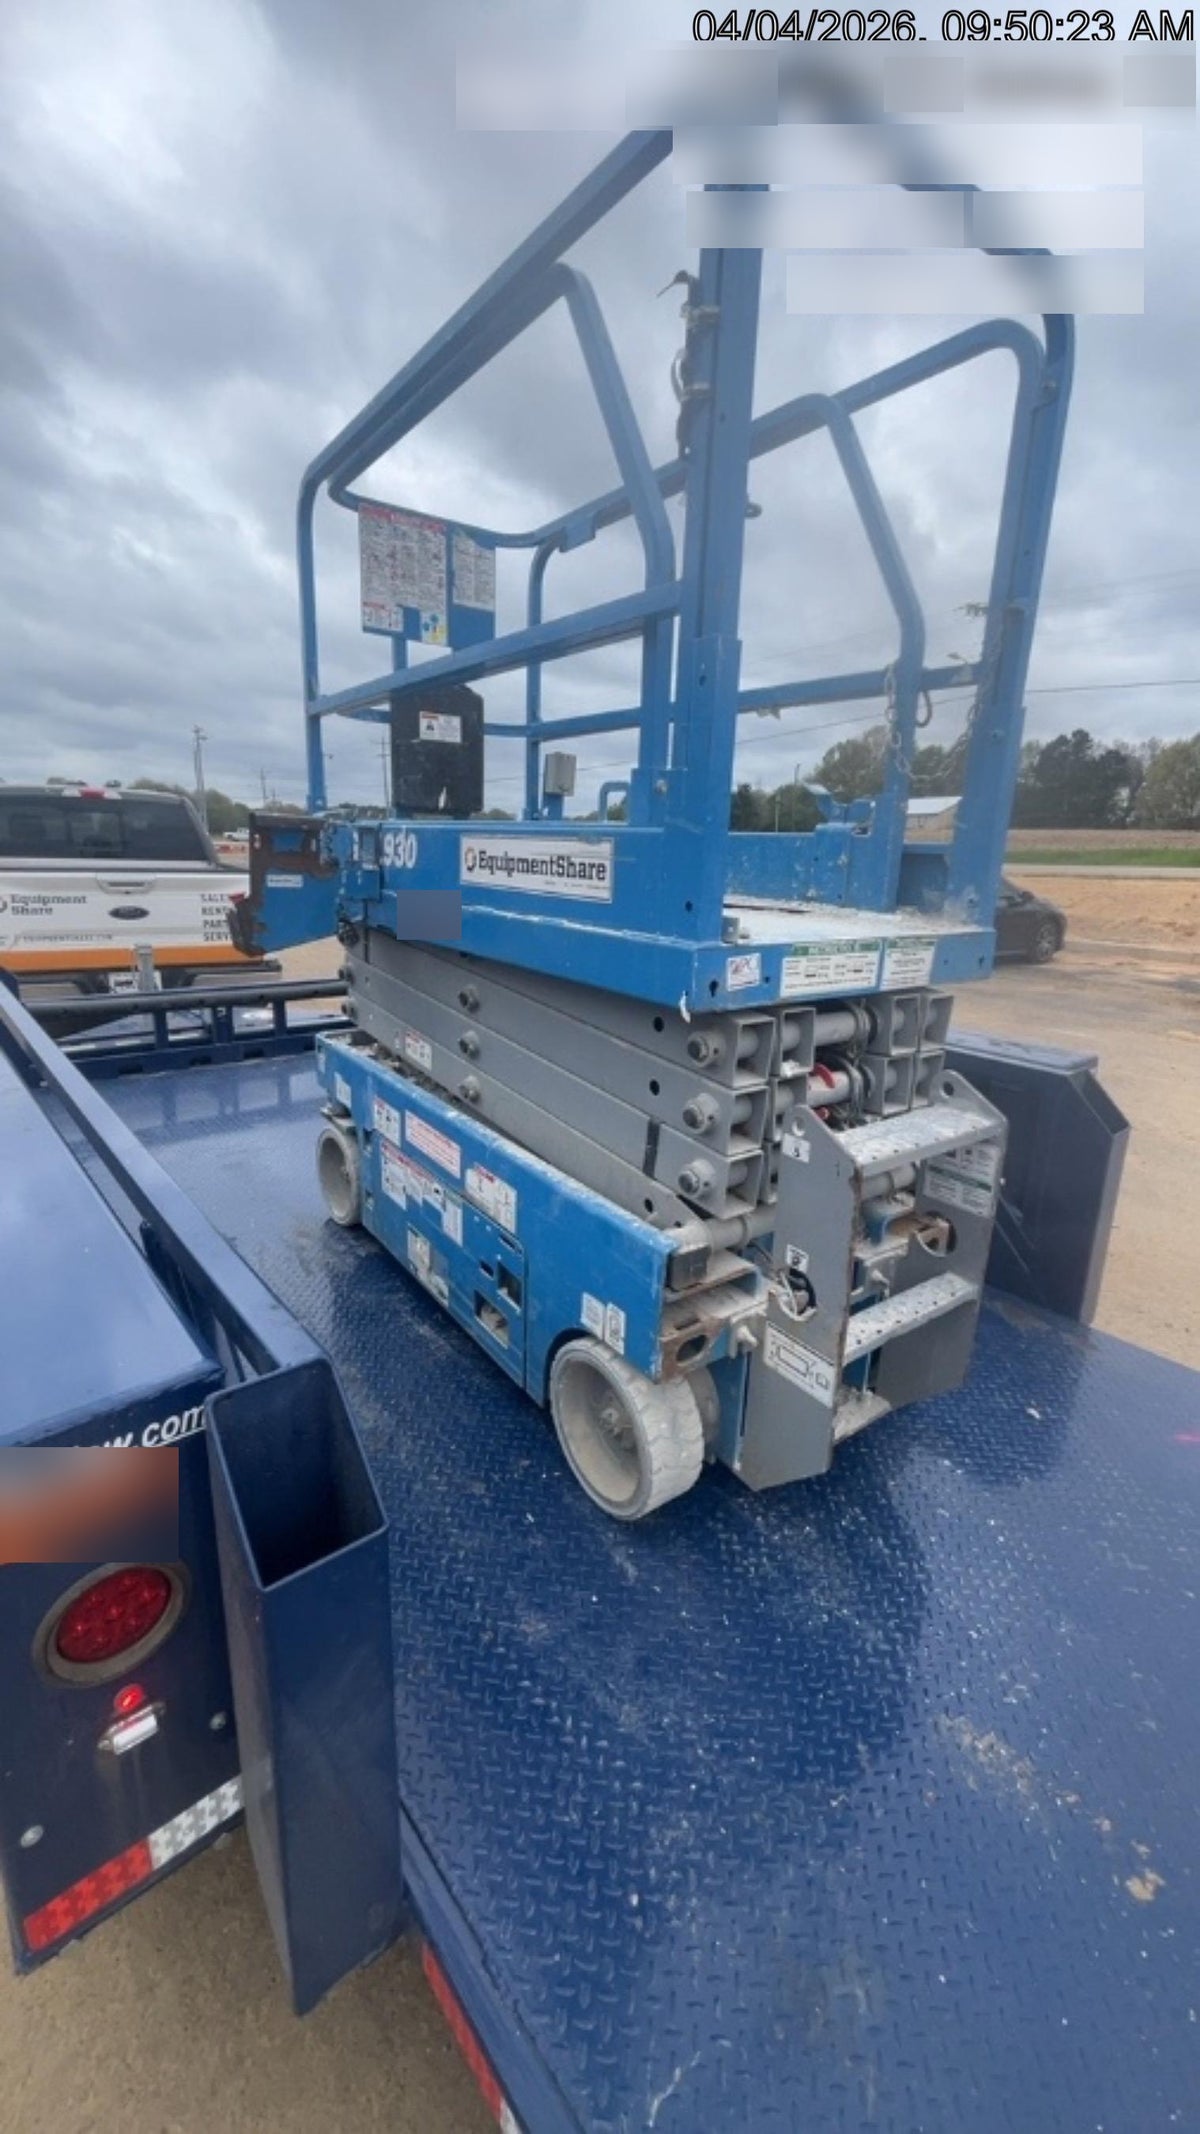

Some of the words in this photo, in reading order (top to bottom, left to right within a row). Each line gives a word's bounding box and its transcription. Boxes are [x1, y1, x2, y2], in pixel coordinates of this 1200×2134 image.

[478, 850, 607, 881] EquipmentShare
[203, 919, 230, 928] PART
[203, 931, 231, 942] SERV
